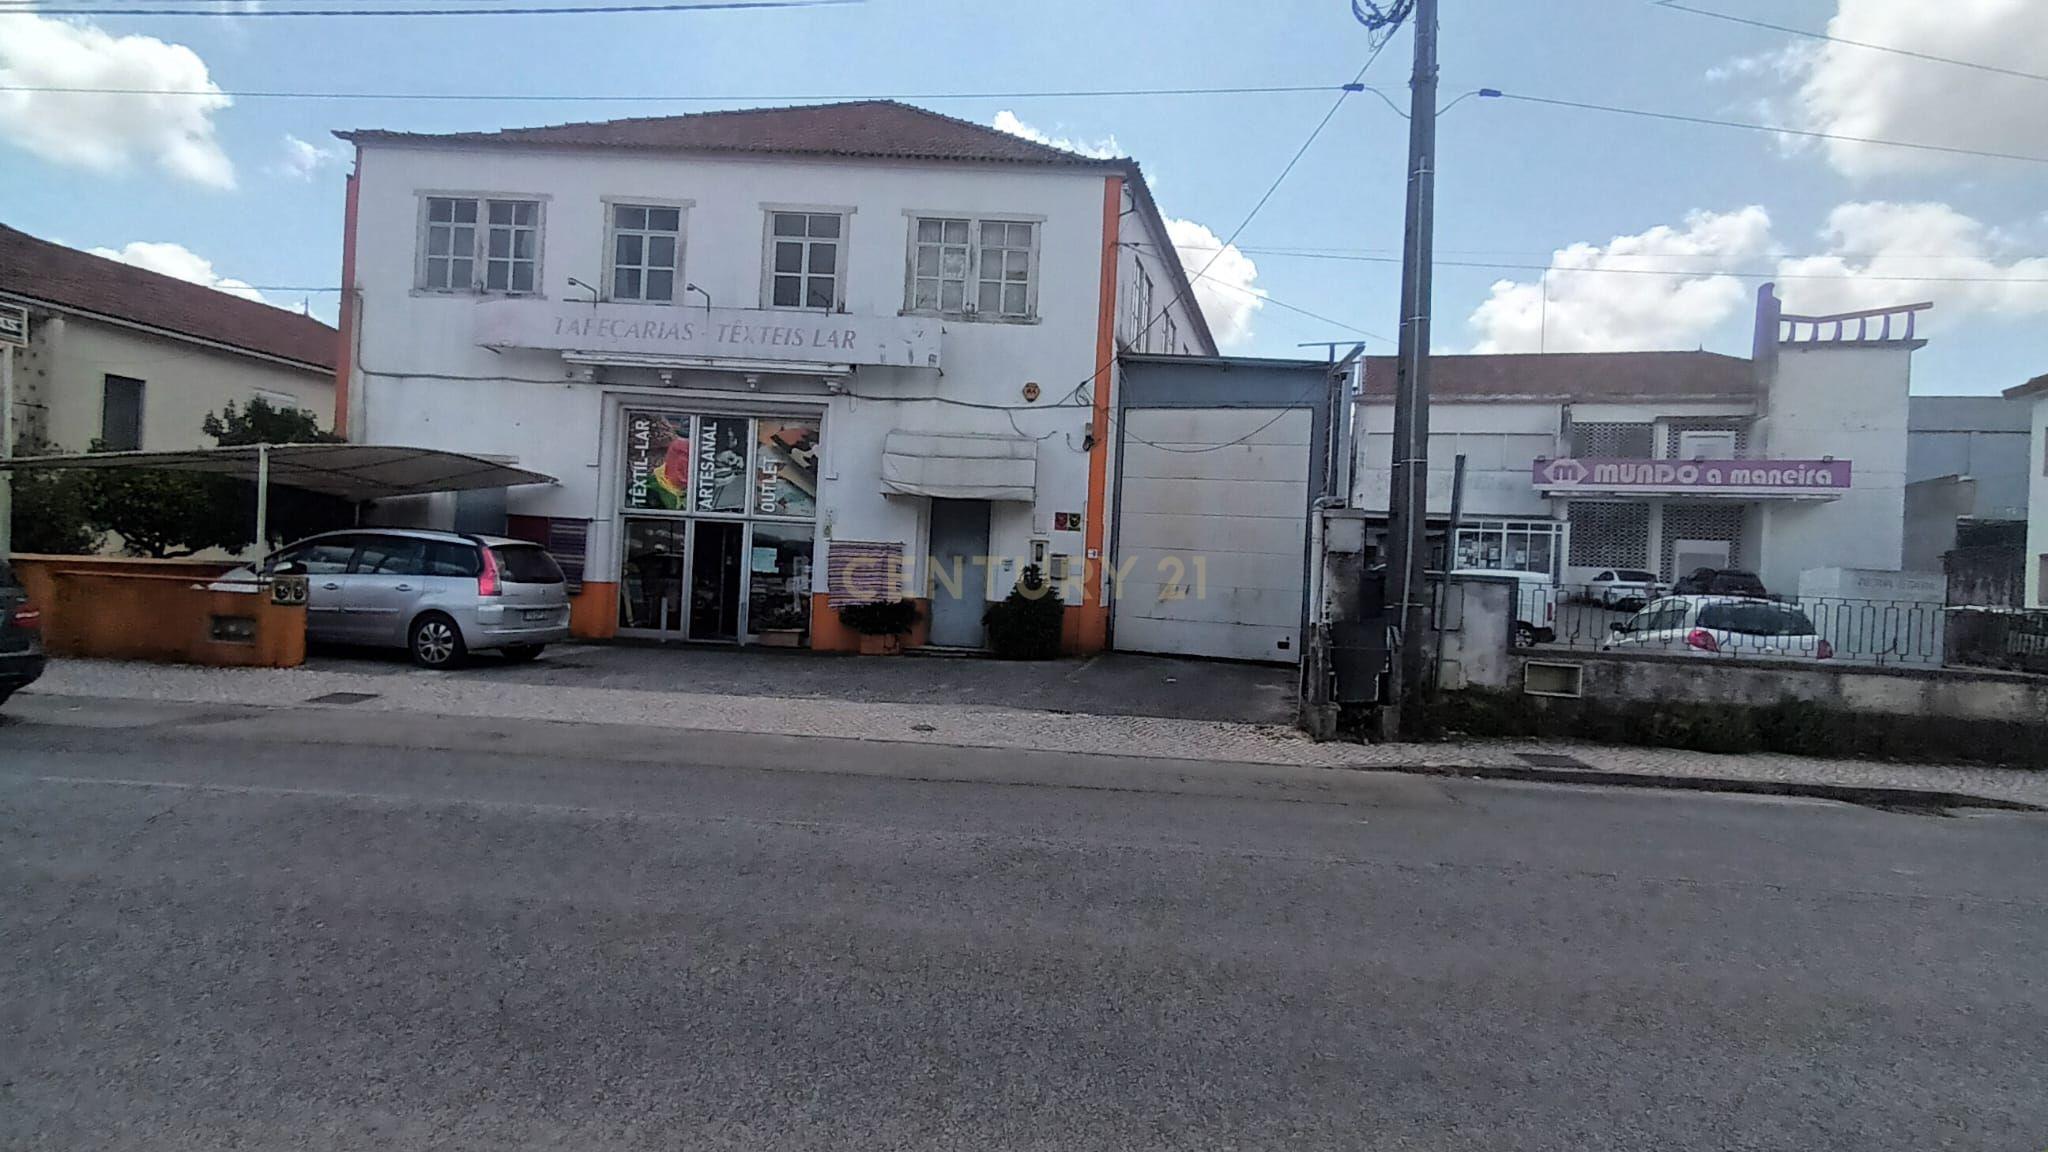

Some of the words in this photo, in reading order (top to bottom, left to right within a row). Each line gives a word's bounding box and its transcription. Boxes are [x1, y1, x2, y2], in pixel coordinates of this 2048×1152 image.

[812, 328, 857, 350] LAR
[699, 422, 717, 512] ARTESANAL
[761, 456, 779, 513] OUTLET
[1730, 464, 1832, 485] maneira
